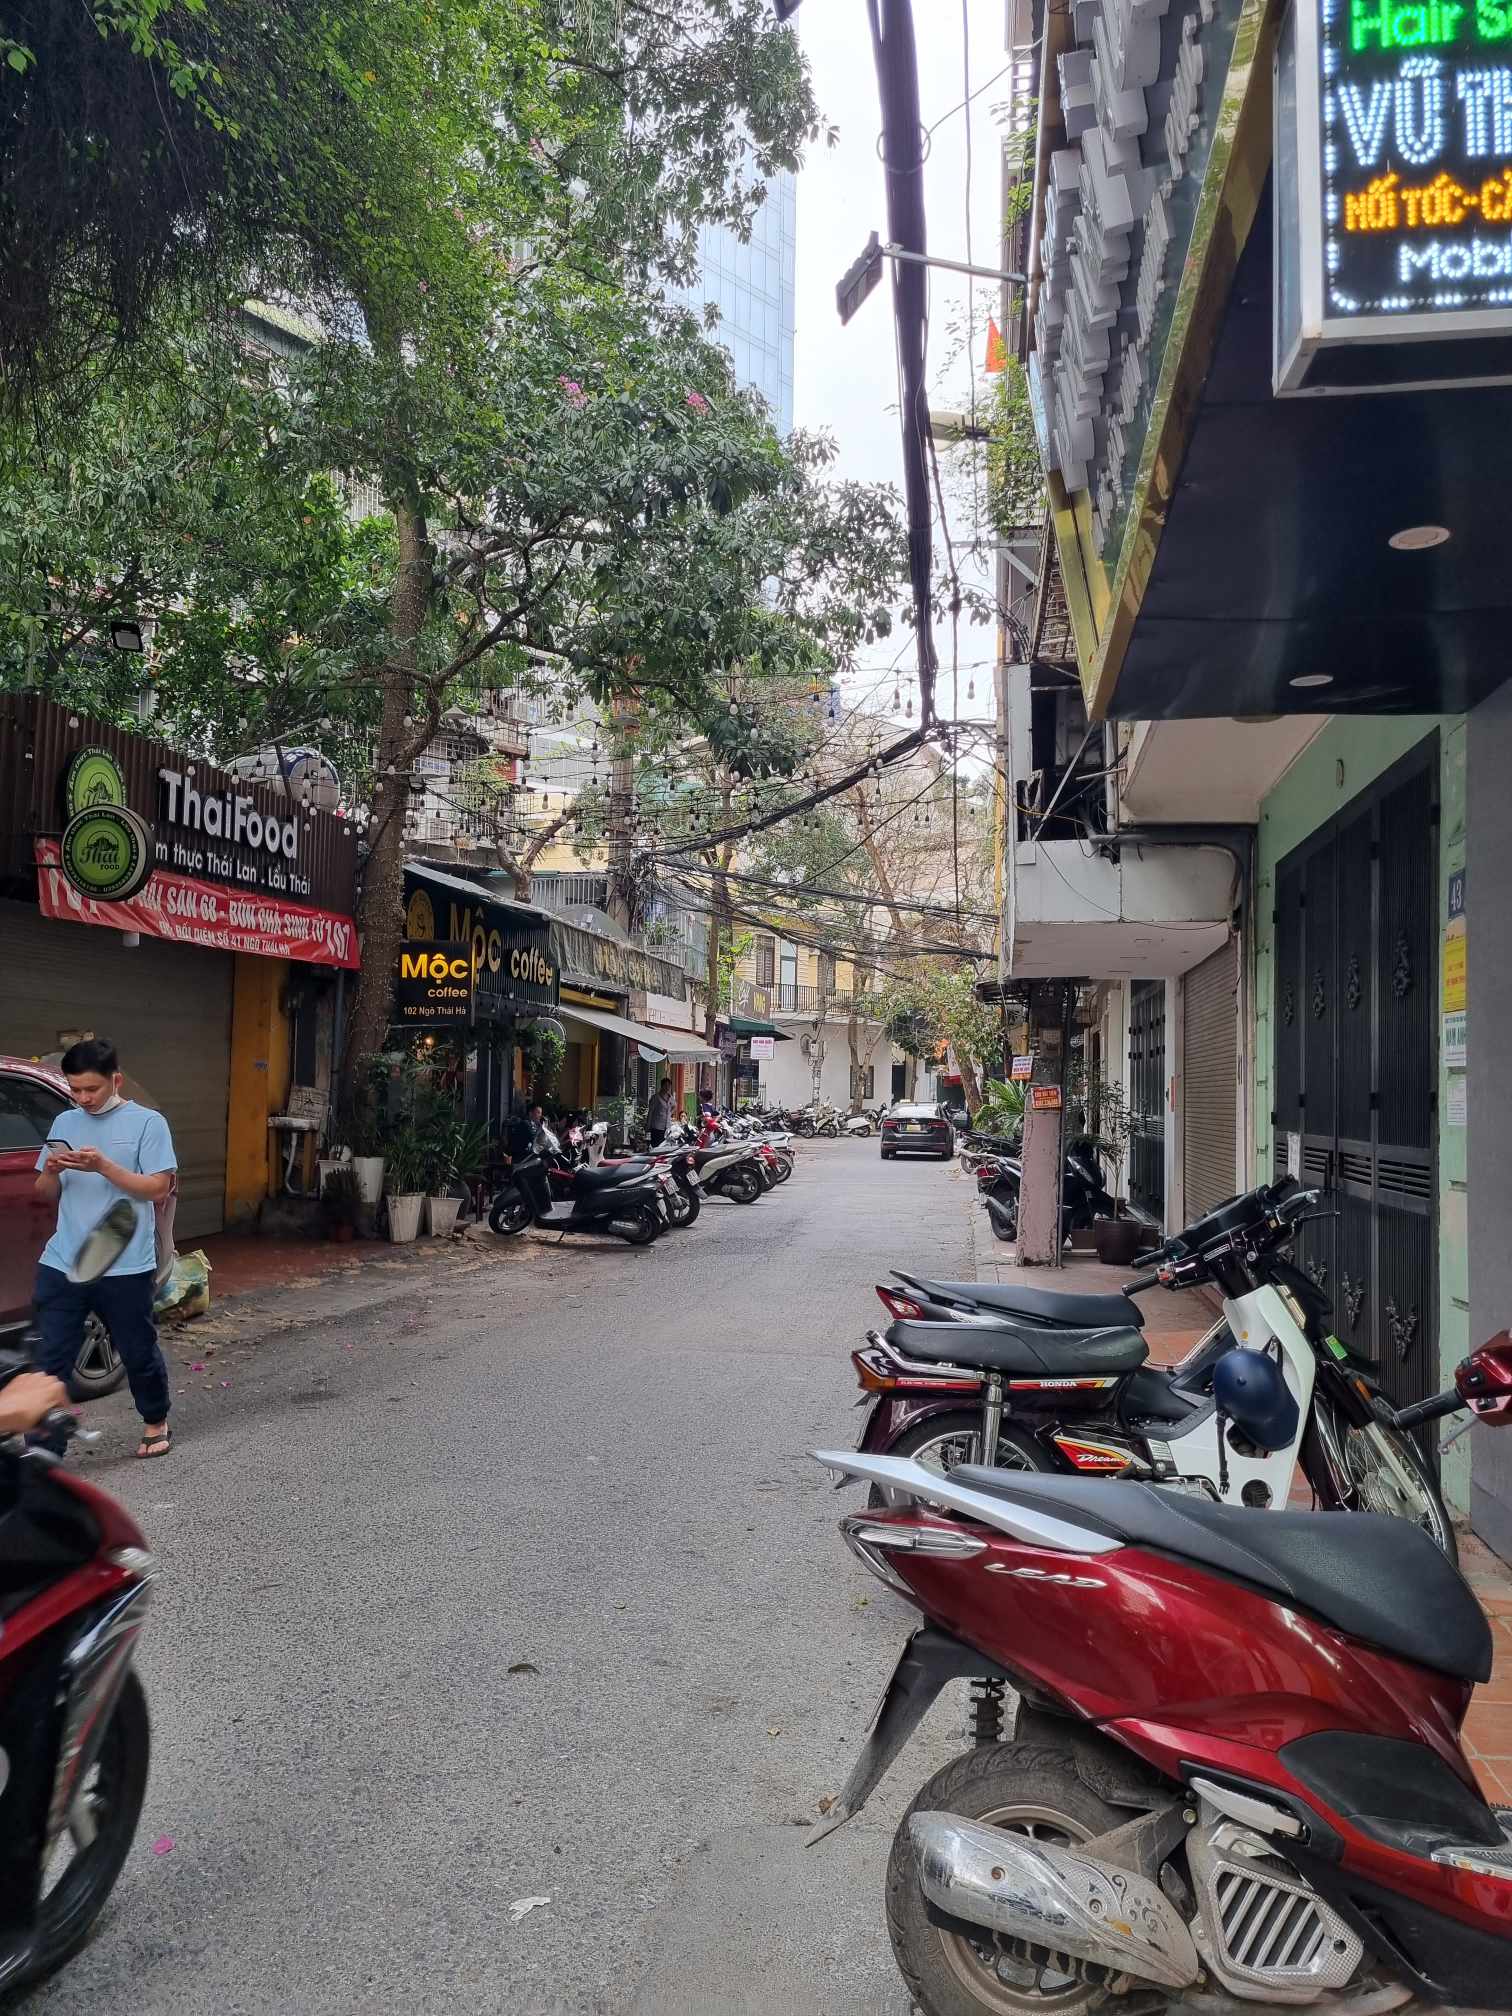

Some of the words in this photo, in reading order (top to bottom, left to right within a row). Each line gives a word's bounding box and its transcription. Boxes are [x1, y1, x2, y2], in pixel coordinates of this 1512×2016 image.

[1352, 0, 1464, 50] Hair
[1477, 0, 1512, 39] S
[159, 770, 298, 860] ThaiFood
[173, 846, 203, 874] thực
[207, 849, 234, 878] Thái
[236, 857, 257, 880] Lan
[290, 872, 312, 896] Thái
[200, 894, 217, 923] 68
[1450, 879, 1463, 911] 43
[401, 952, 469, 985] Mộc
[511, 946, 553, 986] coffee
[427, 986, 469, 998] coffee
[403, 1006, 417, 1015] 102
[418, 1006, 435, 1017] Ngõ
[437, 1006, 454, 1015] Thái
[1039, 1380, 1078, 1388] HONDA
[984, 1562, 1108, 1589] LEAD
